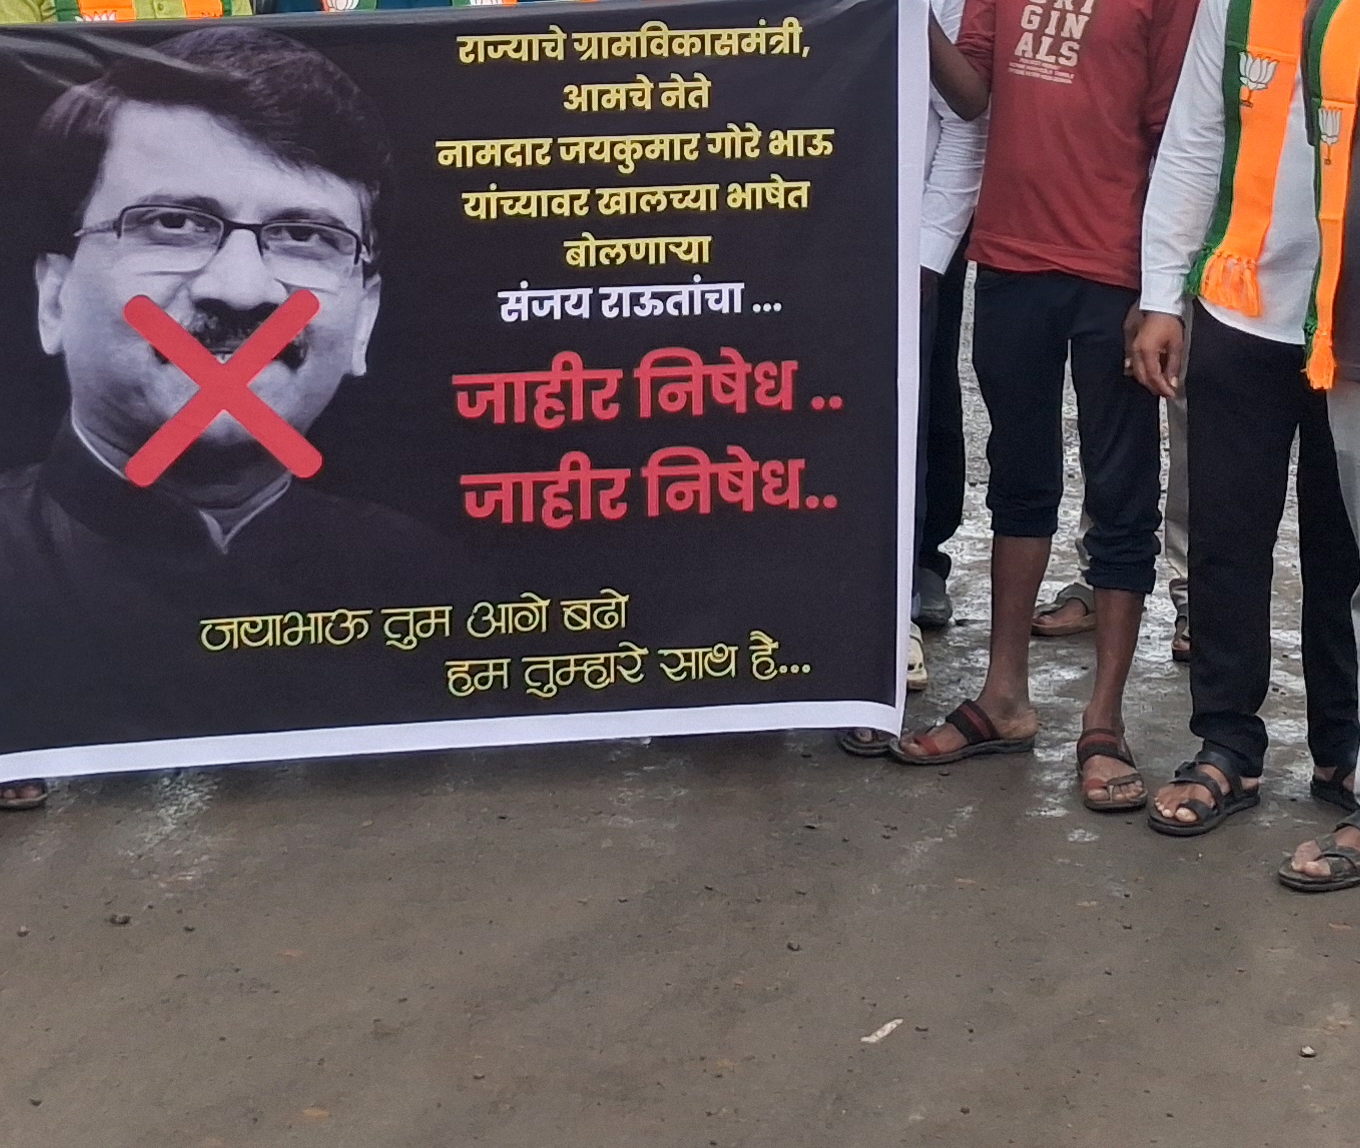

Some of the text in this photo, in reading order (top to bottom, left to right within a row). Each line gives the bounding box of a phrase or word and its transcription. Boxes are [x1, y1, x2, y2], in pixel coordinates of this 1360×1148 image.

[457, 17, 810, 63] राज्याचे ग्रामविकासमंत्री,
[563, 72, 711, 111] आमचे नेते
[436, 123, 834, 173] नामदार जयकुमार गोरे भाऊ
[462, 174, 810, 219] यांच्यावर खालच्या भाषेत
[497, 280, 592, 322] संजय
[599, 273, 744, 317] राऊतांचा
[451, 351, 623, 429] जाहीर
[634, 346, 798, 419] निषेध
[460, 451, 631, 529] जाहीर
[199, 588, 630, 651] जयाभाऊ तुम आगे बढो
[445, 657, 511, 697] हम
[521, 642, 648, 698] तुम्हारे
[658, 643, 738, 683] साथ
